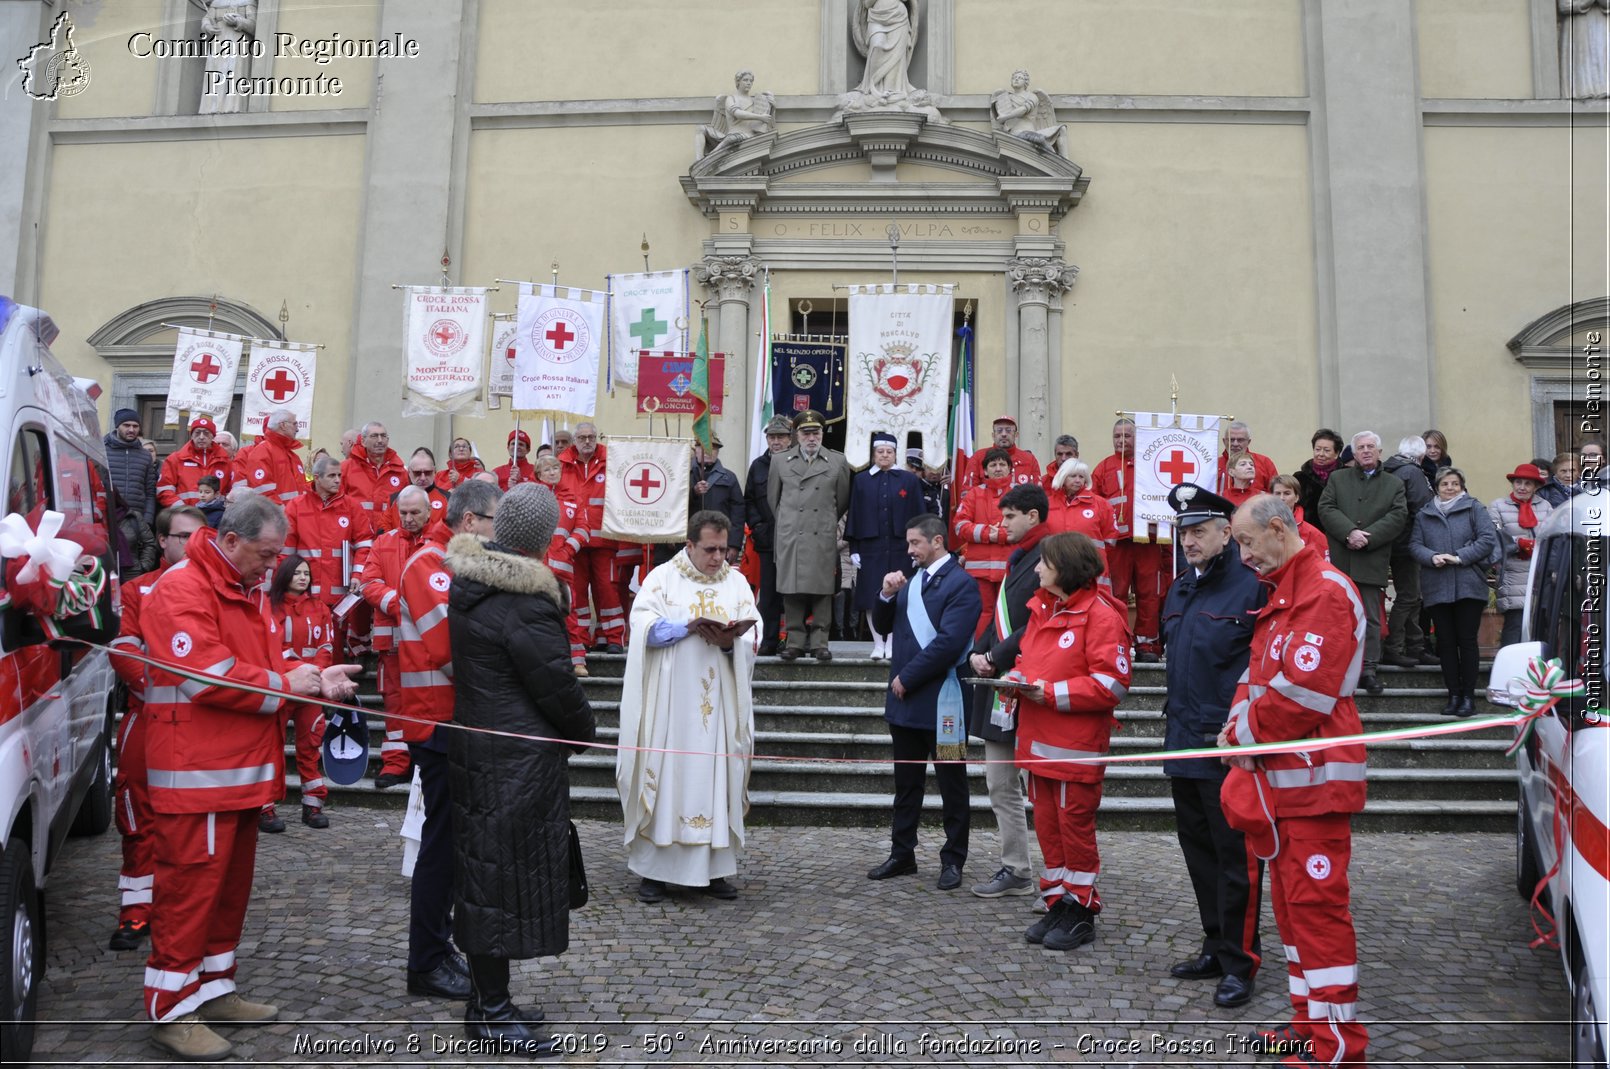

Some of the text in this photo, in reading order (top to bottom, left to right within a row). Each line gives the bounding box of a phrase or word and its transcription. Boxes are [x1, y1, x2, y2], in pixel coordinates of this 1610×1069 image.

[729, 217, 738, 230] S
[1028, 218, 1042, 233] Q
[774, 223, 788, 236] O
[809, 223, 864, 236] FELIX
[623, 289, 648, 298] CROCE
[416, 295, 480, 304] CROCE ROSSA
[880, 330, 920, 338] MONCALVO
[180, 346, 195, 362] CROCE
[216, 344, 233, 369] ITALIANA
[250, 355, 311, 388] CROCE ROSSA ITALIANA
[565, 375, 589, 384] Italiana
[658, 401, 696, 410] MONCALV
[1142, 433, 1213, 464] CROCE ROSSA ITALIANA
[616, 460, 630, 479] CROCE
[657, 457, 676, 482] ITALIANA
[616, 509, 659, 518] DELEGAZIONE
[623, 517, 665, 527] MONCALVO
